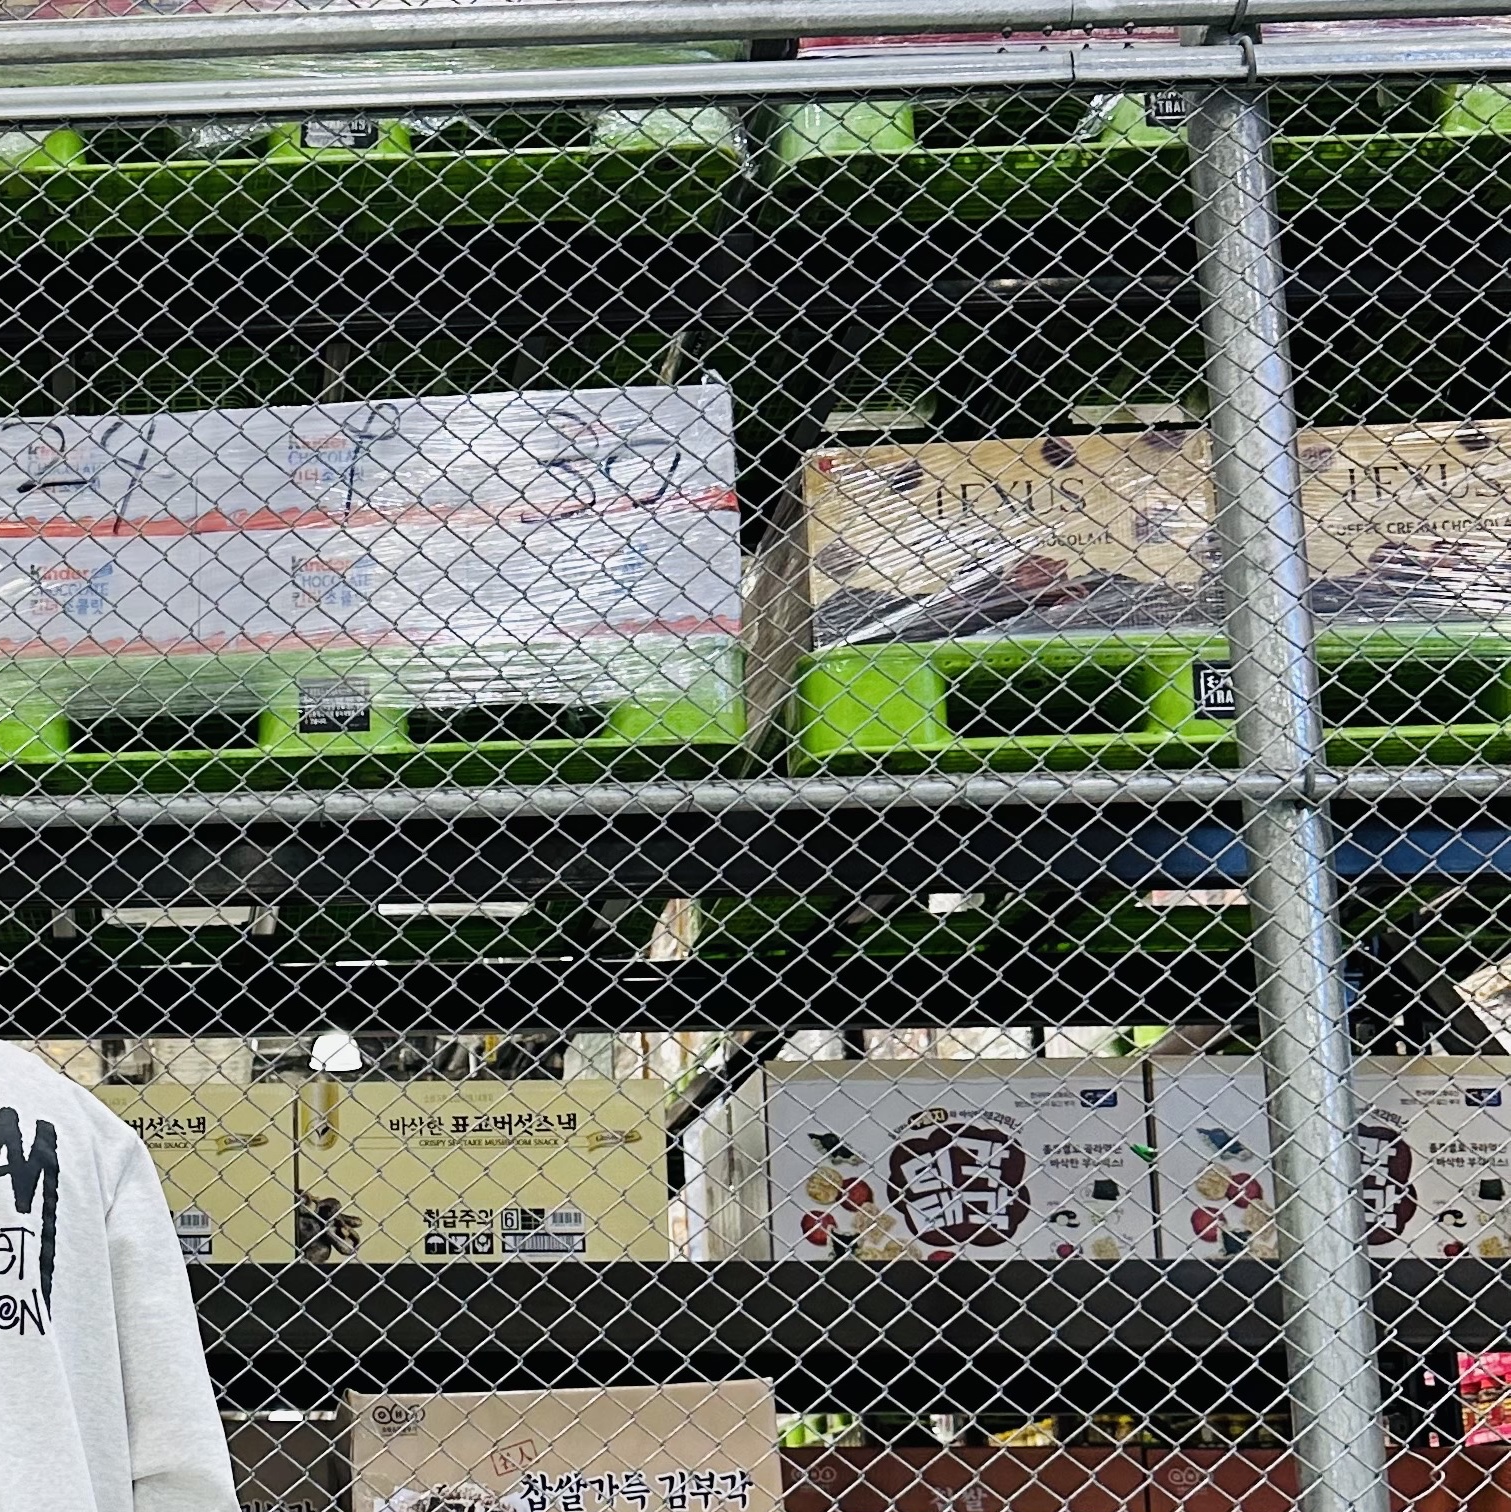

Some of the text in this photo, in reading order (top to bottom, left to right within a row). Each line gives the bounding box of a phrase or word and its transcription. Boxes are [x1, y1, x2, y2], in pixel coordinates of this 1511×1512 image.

[422, 1208, 495, 1230] 취급주의
[520, 1468, 755, 1512] 찹쌀가득 김부각
